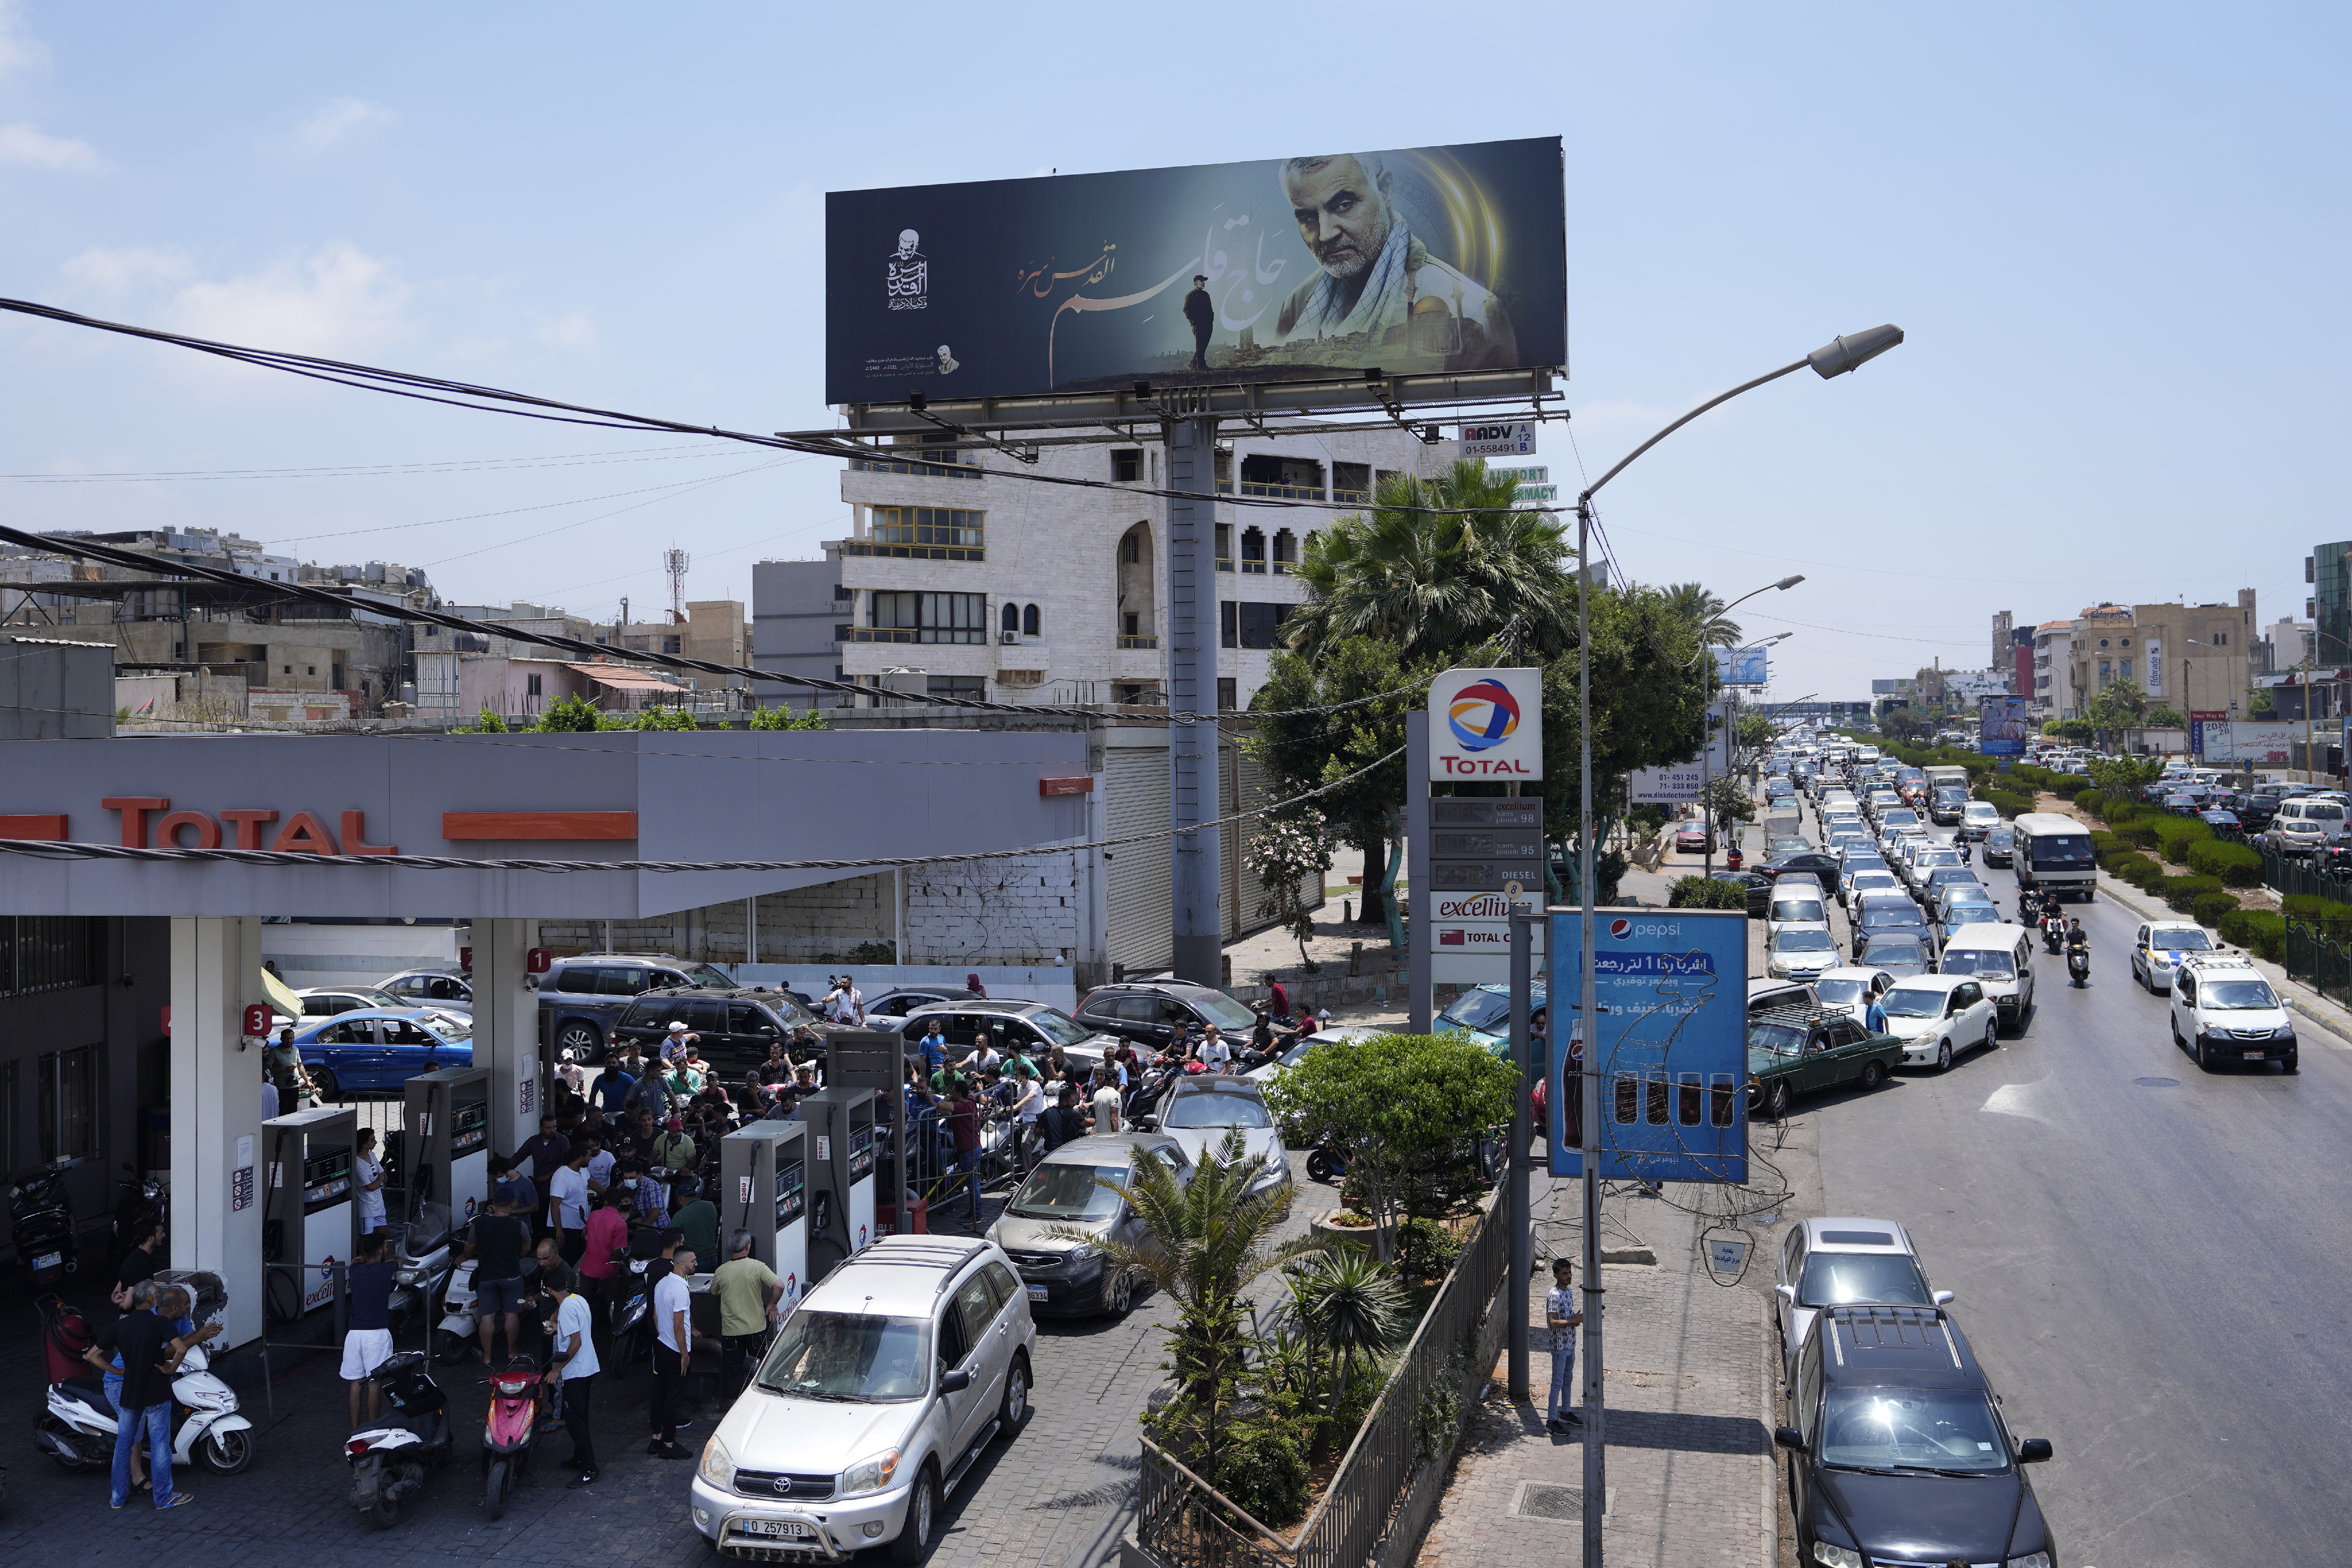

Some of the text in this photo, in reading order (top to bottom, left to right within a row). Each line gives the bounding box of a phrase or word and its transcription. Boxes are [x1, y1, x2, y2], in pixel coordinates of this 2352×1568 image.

[1465, 425, 1513, 441] AADV
[1517, 433, 1531, 441] 12
[1466, 444, 1514, 454] 01-558491
[1520, 443, 1528, 451] B
[1496, 801, 1536, 811] excellium
[1521, 814, 1534, 823] 98
[1521, 845, 1534, 855] 95
[1502, 871, 1536, 879] DIESEL
[1511, 885, 1517, 894] 8
[1440, 897, 1532, 916] excelliu
[1635, 922, 1680, 938] pepsi
[1466, 933, 1500, 943] TOTAL
[535, 952, 542, 968] 1
[1646, 956, 1652, 970] 1
[253, 1011, 263, 1031] 3
[877, 1223, 895, 1232] BLE
[764, 1522, 802, 1535] 257913
